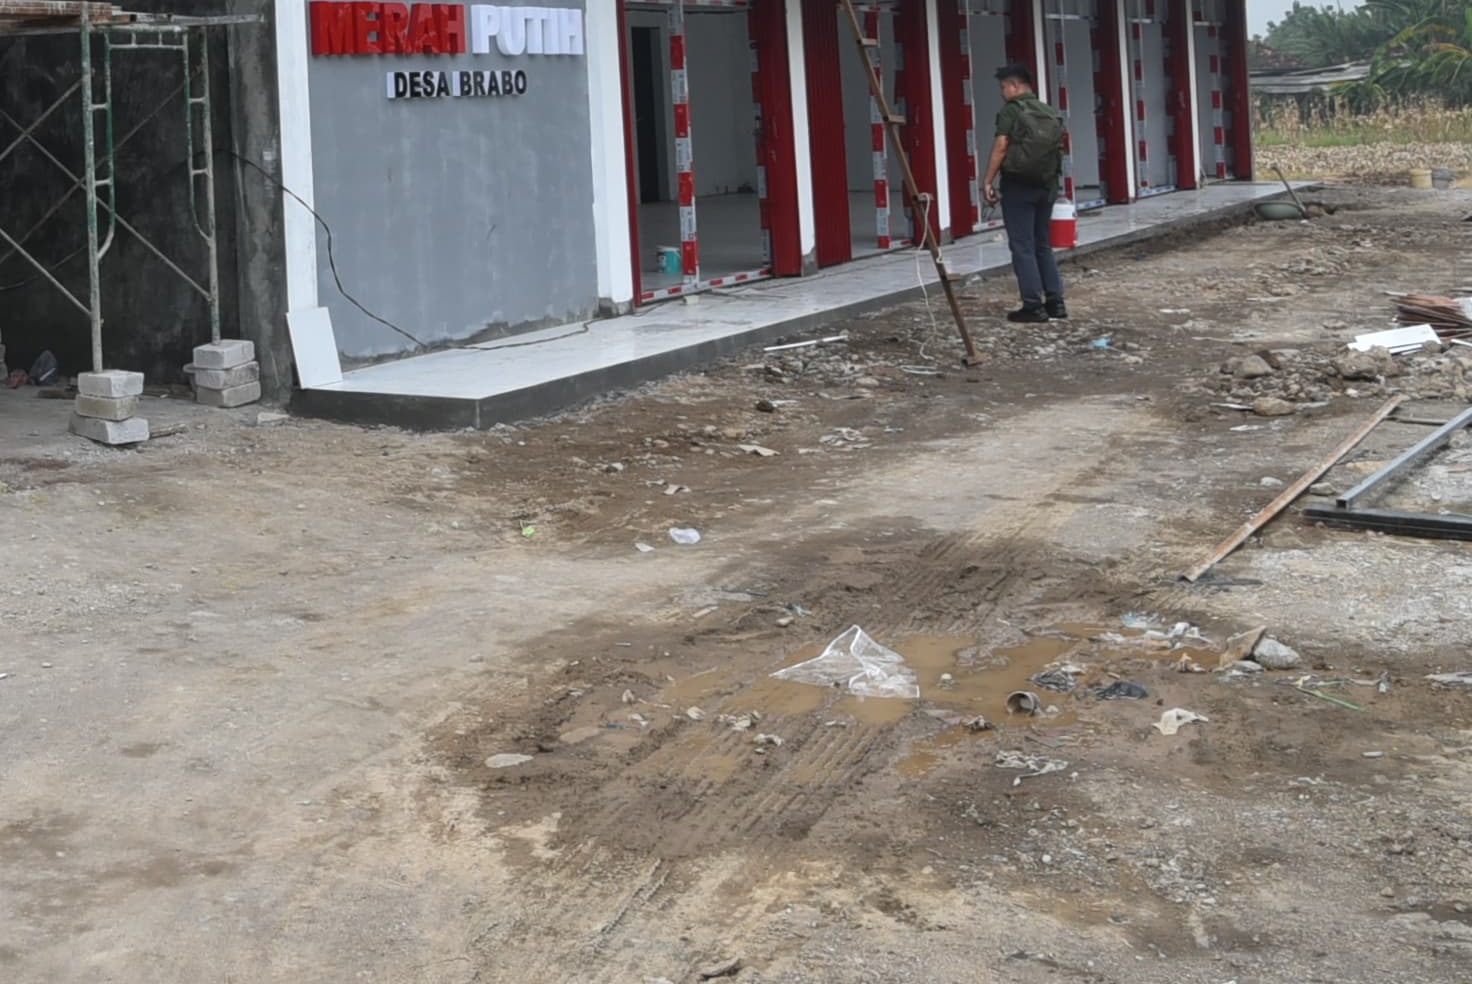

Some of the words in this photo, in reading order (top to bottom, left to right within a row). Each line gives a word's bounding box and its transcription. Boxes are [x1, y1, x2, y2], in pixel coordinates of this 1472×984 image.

[311, 1, 466, 55] MERAH
[471, 5, 584, 55] PUTIH
[392, 71, 450, 98] DESA
[458, 69, 528, 97] BRABO
